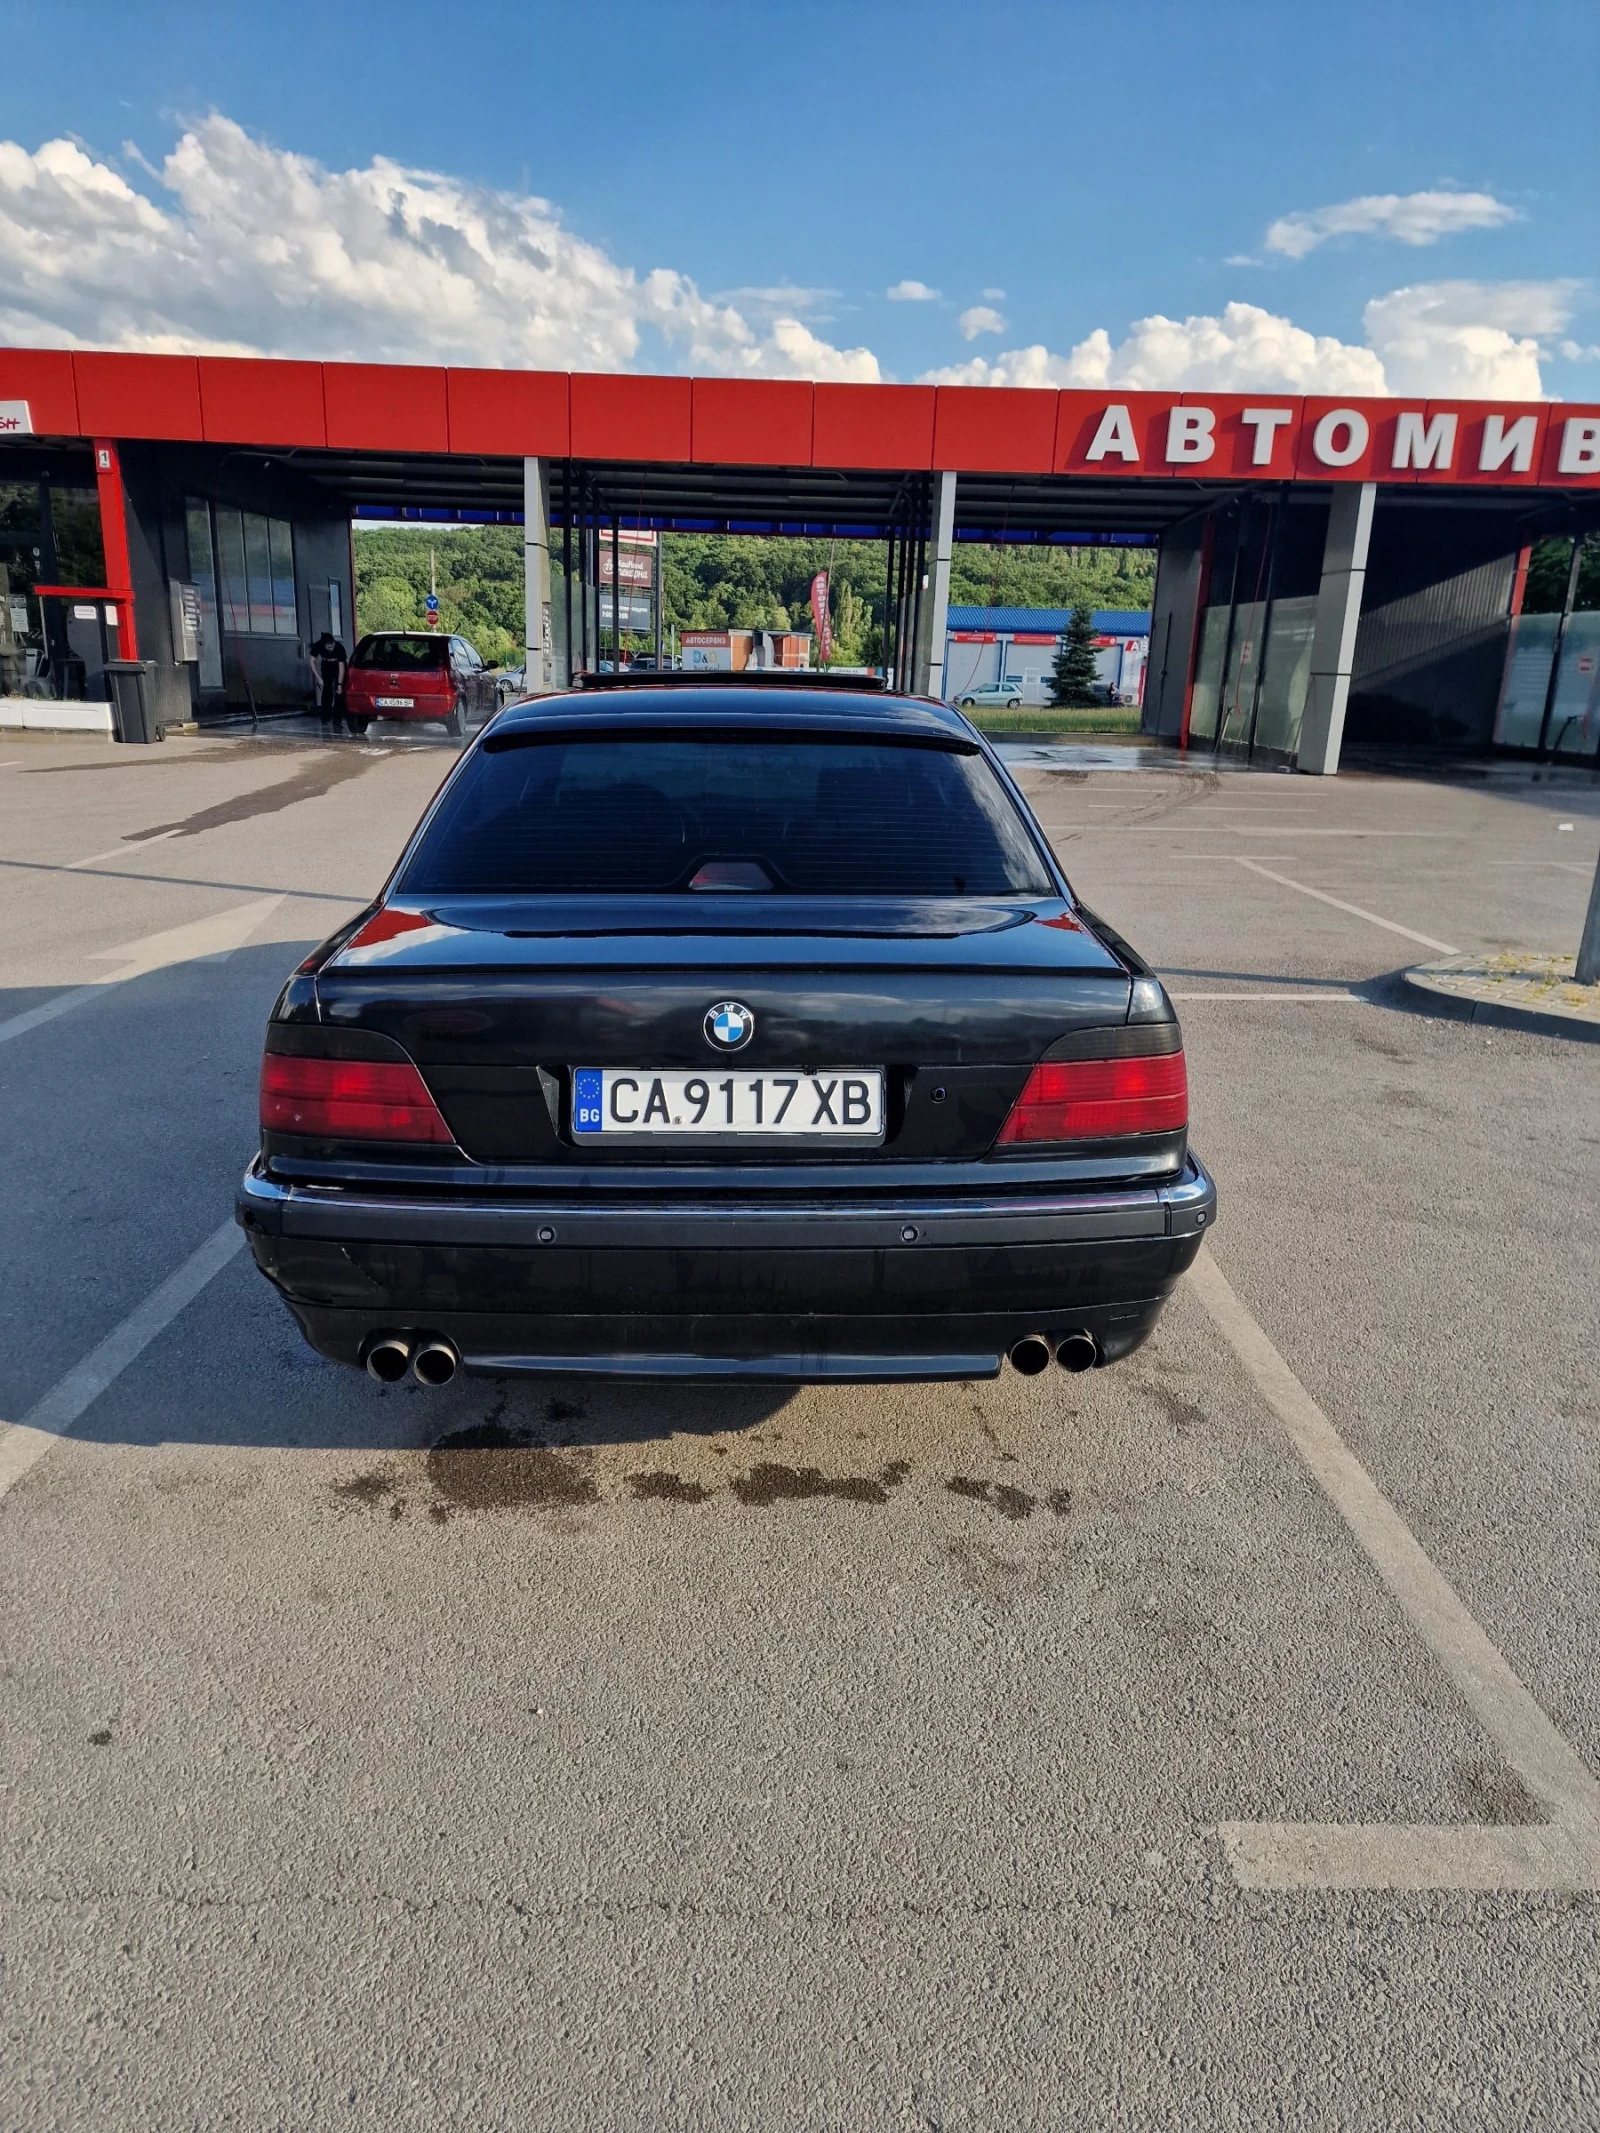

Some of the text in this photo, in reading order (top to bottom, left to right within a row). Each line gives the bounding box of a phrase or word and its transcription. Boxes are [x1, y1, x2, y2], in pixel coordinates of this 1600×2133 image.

[1085, 404, 1600, 475] АВТОМИВ
[101, 452, 108, 463] 1
[685, 636, 726, 644] АВТОСЕРВИЗ
[708, 1004, 750, 1020] BMW
[610, 1078, 871, 1125] CA 9117 XB
[580, 1109, 600, 1123] BG
